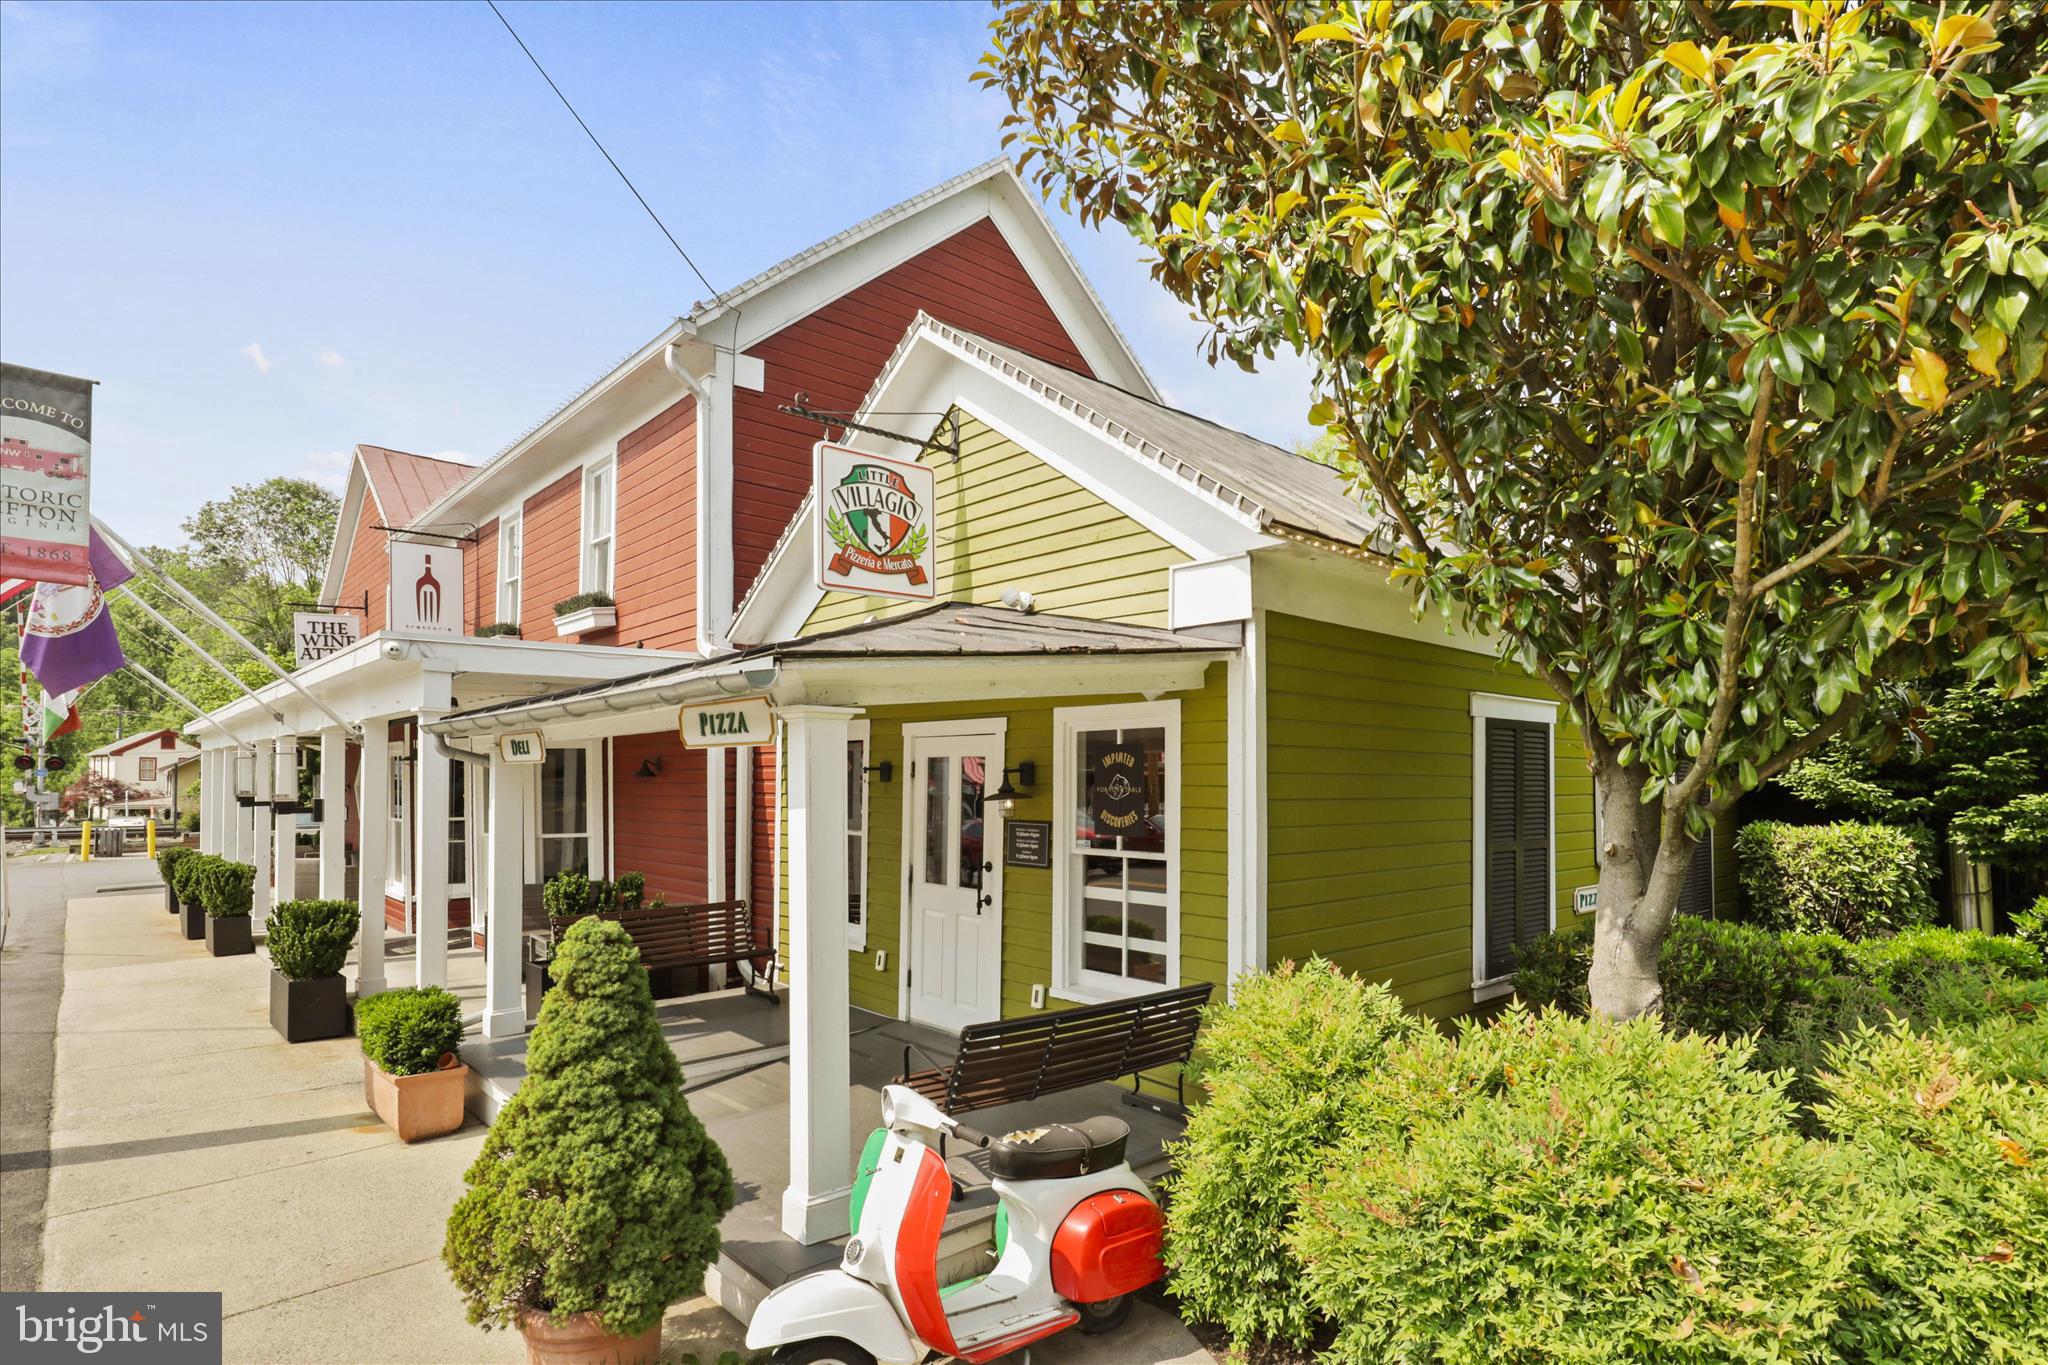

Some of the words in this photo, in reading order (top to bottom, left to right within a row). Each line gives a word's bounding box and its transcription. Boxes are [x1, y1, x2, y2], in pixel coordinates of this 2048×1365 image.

[0, 397, 57, 418] COME
[61, 411, 84, 429] TO
[857, 470, 899, 488] LITTLE
[0, 500, 76, 523] FTON
[836, 486, 917, 521] VILLAGIO
[26, 546, 72, 561] 1868
[845, 546, 875, 569] Pizzeria
[877, 561, 882, 569] e
[884, 558, 913, 571] Mercato
[307, 620, 348, 635] THE
[300, 633, 356, 648] WINE
[300, 647, 341, 660] ATT
[699, 711, 749, 737] PIZZA
[510, 739, 530, 756] DELI
[1100, 809, 1138, 828] DISCOVERIES
[1580, 893, 1598, 908] PIZZ
